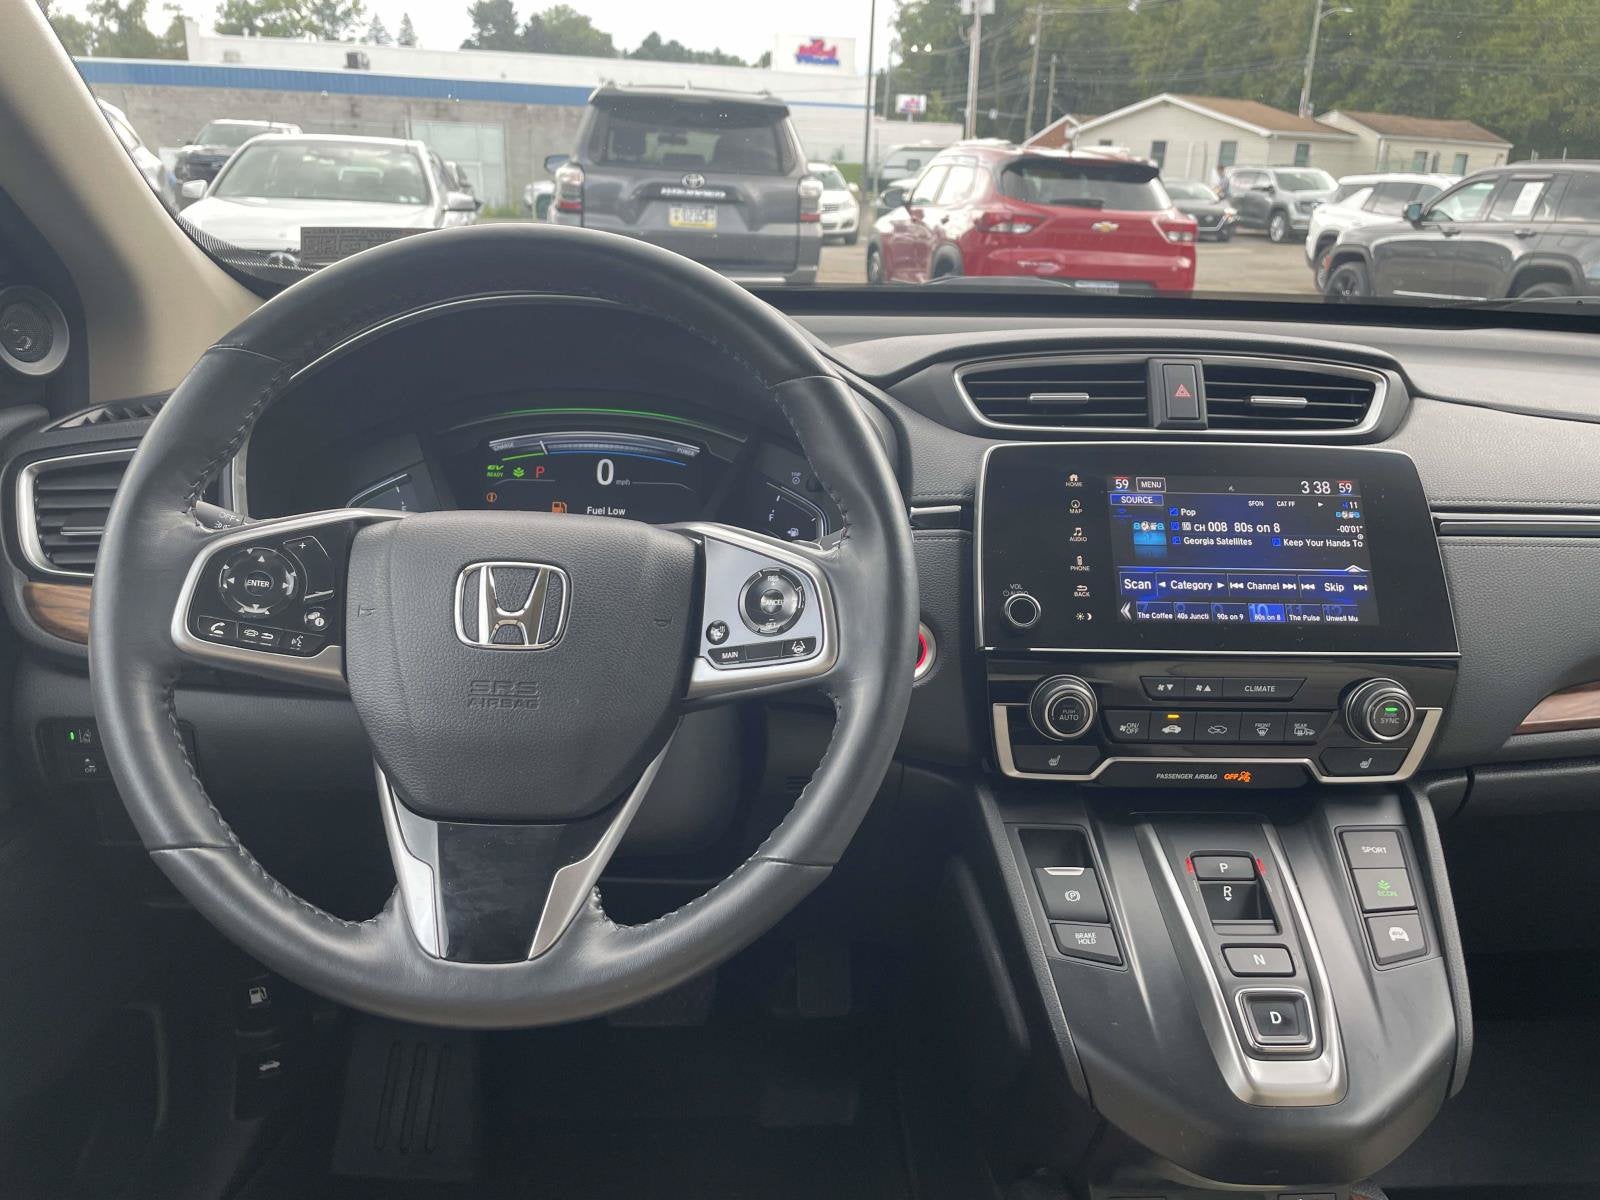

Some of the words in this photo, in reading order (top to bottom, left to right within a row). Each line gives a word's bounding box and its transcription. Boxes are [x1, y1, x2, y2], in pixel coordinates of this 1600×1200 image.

[535, 465, 545, 479] P
[596, 458, 614, 486] 0
[1115, 479, 1129, 489] 59
[1338, 483, 1352, 493] 59
[1121, 495, 1153, 504] SOURCE
[586, 506, 606, 515] Fuel
[607, 507, 626, 516] Low
[1180, 507, 1196, 517] Pop
[1194, 524, 1206, 532] CH
[1208, 521, 1228, 532] 008
[1234, 522, 1253, 533] 80s
[1256, 524, 1271, 533] on
[1273, 522, 1281, 533] 8
[1183, 536, 1215, 547] Georgia
[1216, 537, 1253, 546] Satellites
[1283, 539, 1304, 549] Keep
[1305, 539, 1324, 547] Your
[1326, 540, 1351, 548] Hands
[1352, 540, 1363, 548] To
[247, 579, 270, 588] ENTER
[1124, 578, 1152, 590] Scan
[1170, 579, 1213, 591] Category
[1247, 581, 1280, 590] Channel
[1324, 582, 1345, 592] Skip
[721, 651, 739, 660] MAIN
[1244, 685, 1276, 693] CLIMATE
[1155, 772, 1194, 780] PASSENGER
[1361, 845, 1388, 854] SPORT
[1218, 862, 1229, 873] P
[1222, 885, 1233, 897] R
[1252, 954, 1267, 966] N
[1269, 1011, 1282, 1025] D
